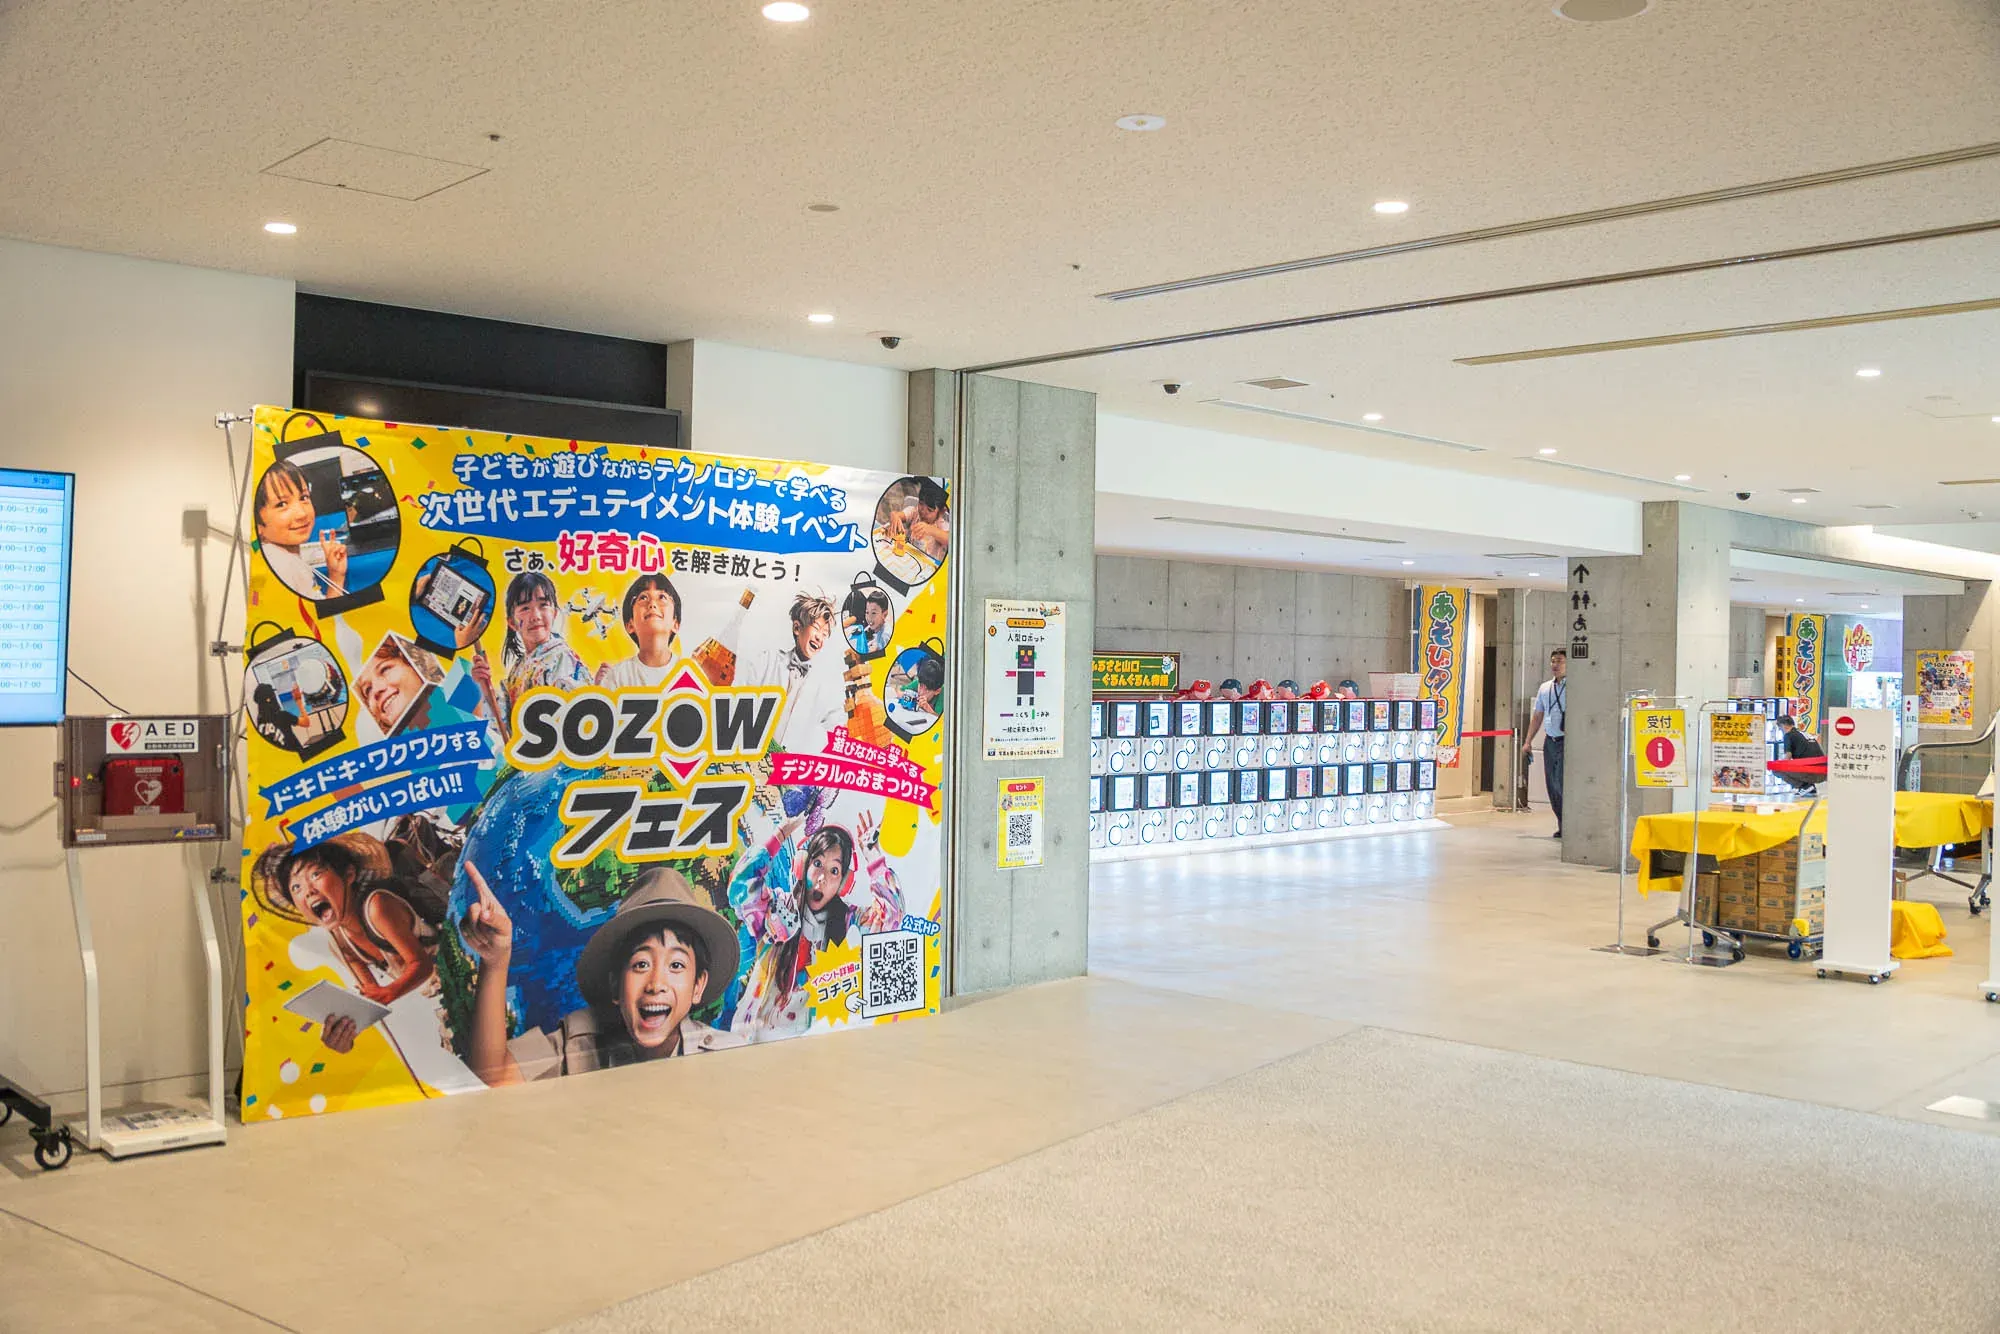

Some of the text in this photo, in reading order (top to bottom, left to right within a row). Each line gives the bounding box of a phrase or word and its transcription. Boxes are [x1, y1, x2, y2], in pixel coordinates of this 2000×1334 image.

[454, 454, 847, 511] 子どもが遊びながらテクノロジーで学べる
[1007, 633, 1045, 642] 人型ロボット
[145, 722, 195, 736] AED
[516, 697, 778, 759] SOZOW
[1647, 715, 1672, 729] 受付
[832, 735, 918, 778] 遊びながら学べる
[1834, 742, 1887, 751] これより先への
[1834, 752, 1887, 761] 入場にはチケット
[273, 730, 482, 812] ドキドキ・ワクワクする
[1834, 763, 1870, 771] が必要です
[781, 759, 928, 802] デジタルのおまつり!?
[302, 773, 464, 844] 体験がいっぱい!!
[561, 785, 747, 856] フェス
[902, 916, 940, 936] 公式HP
[811, 963, 860, 986] イベント詳細は
[818, 976, 859, 1002] コチラ!
